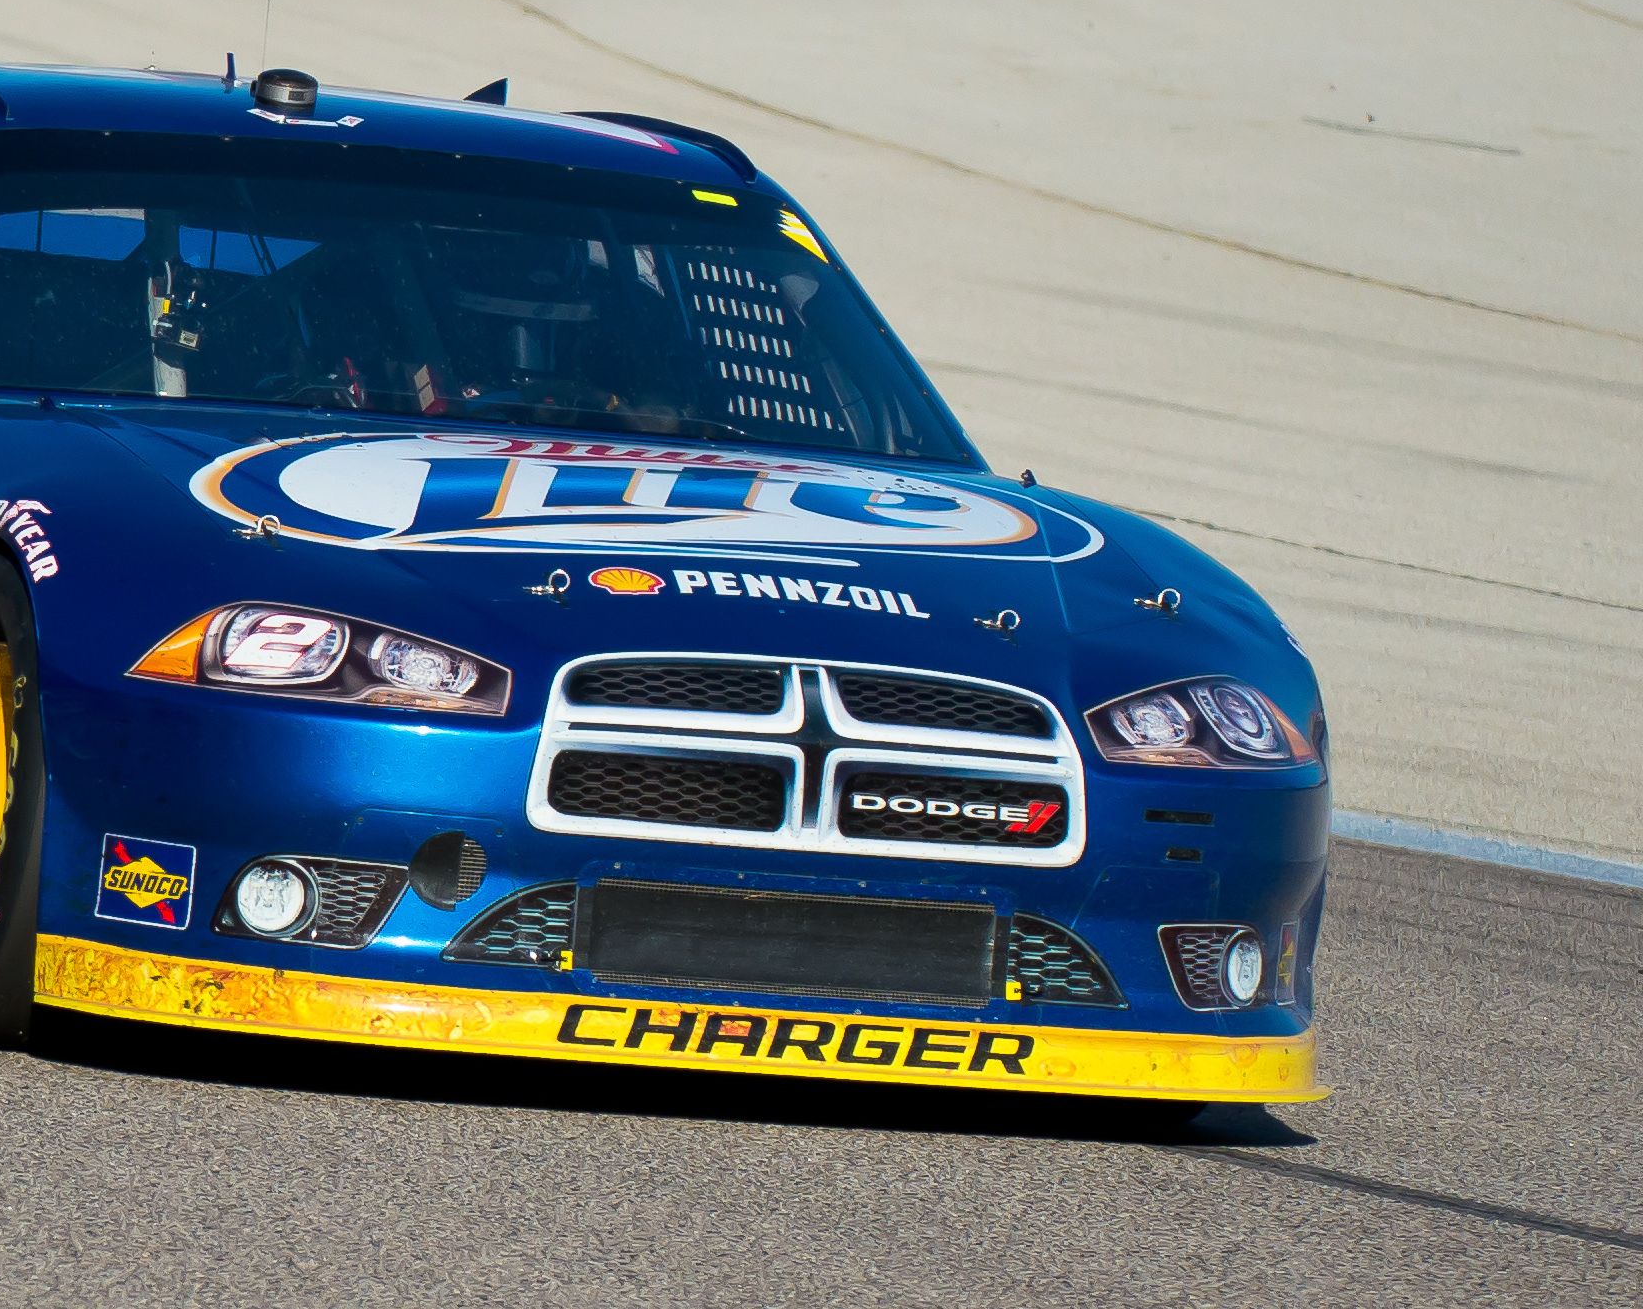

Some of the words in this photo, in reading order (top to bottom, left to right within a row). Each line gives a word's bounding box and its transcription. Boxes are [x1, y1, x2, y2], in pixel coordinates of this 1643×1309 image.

[673, 568, 931, 619] PENNZOIL
[223, 613, 334, 670] 2
[852, 793, 1030, 823] DODGE
[108, 868, 187, 897] SUNOCO
[555, 1003, 1035, 1076] CHARGER
